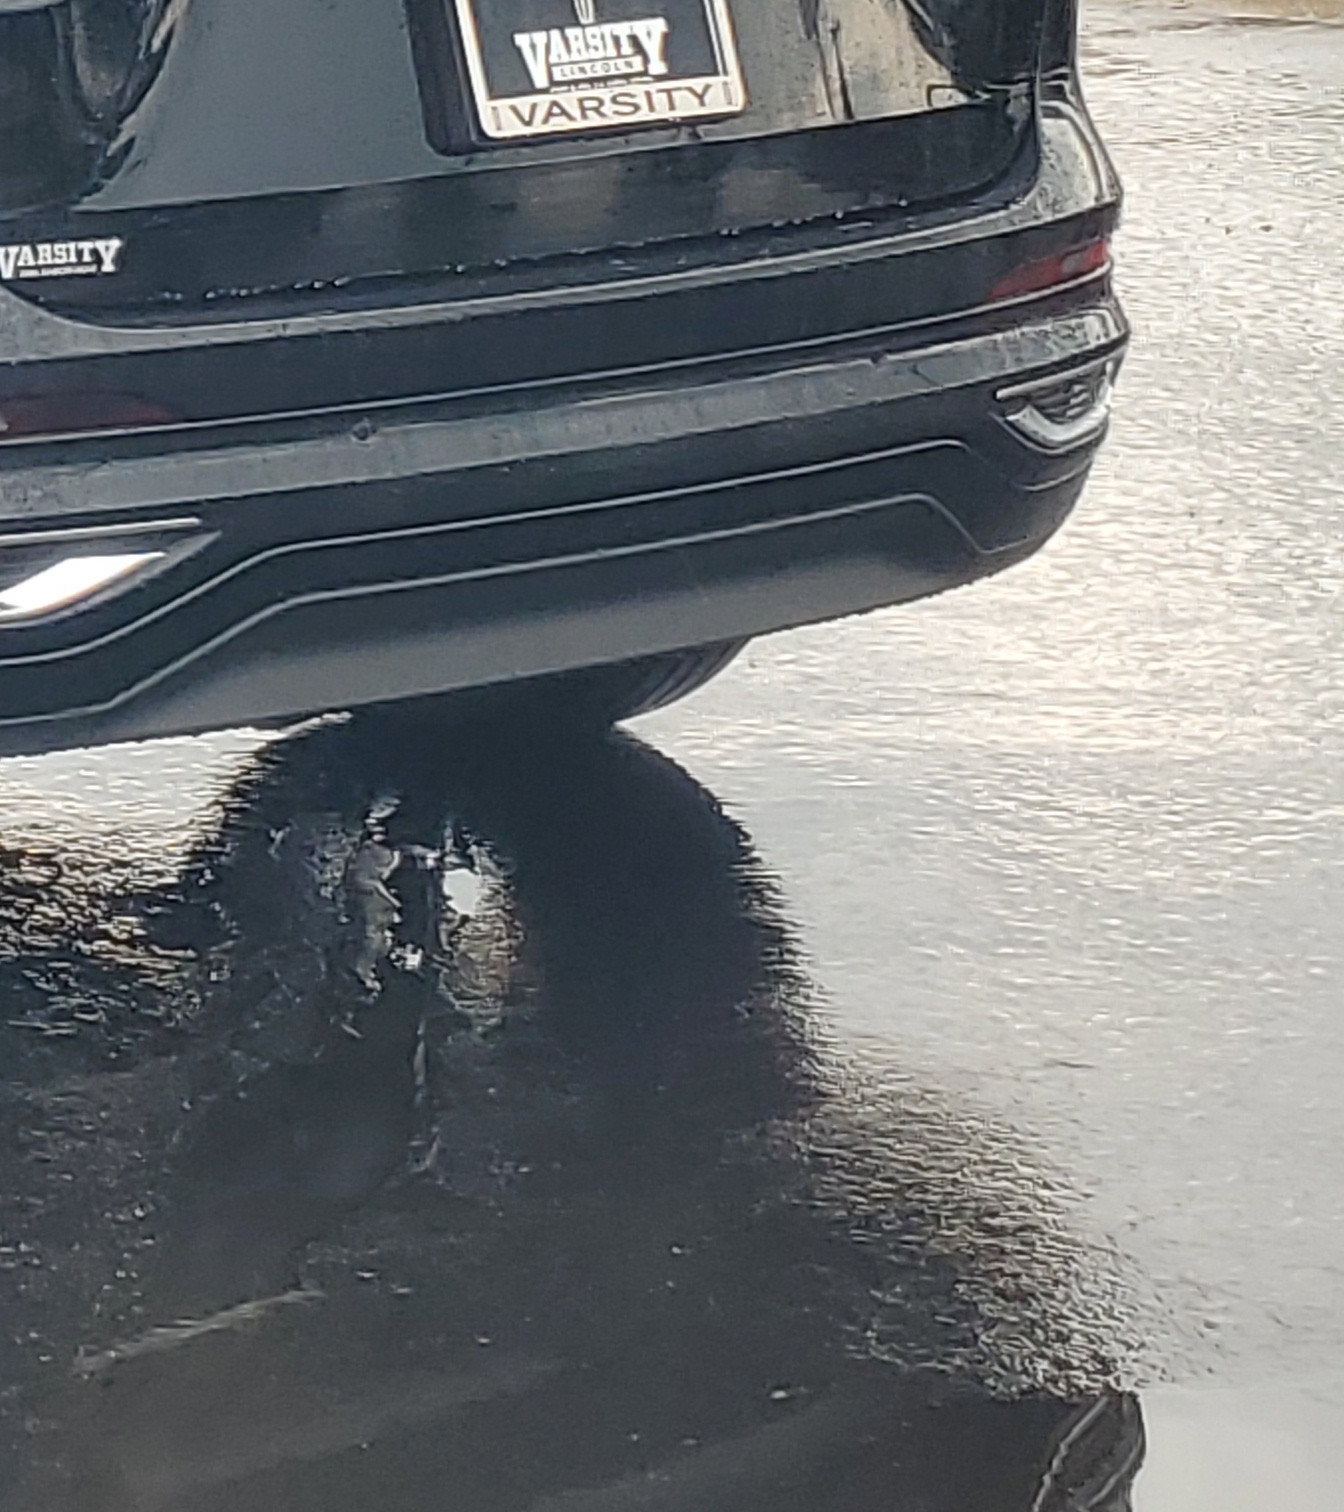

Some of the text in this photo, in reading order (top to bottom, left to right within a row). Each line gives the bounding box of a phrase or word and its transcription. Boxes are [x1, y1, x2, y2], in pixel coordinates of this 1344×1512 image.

[513, 16, 669, 90] VARSITY
[559, 60, 635, 78] LINCOLN
[508, 83, 714, 128] VARSITY
